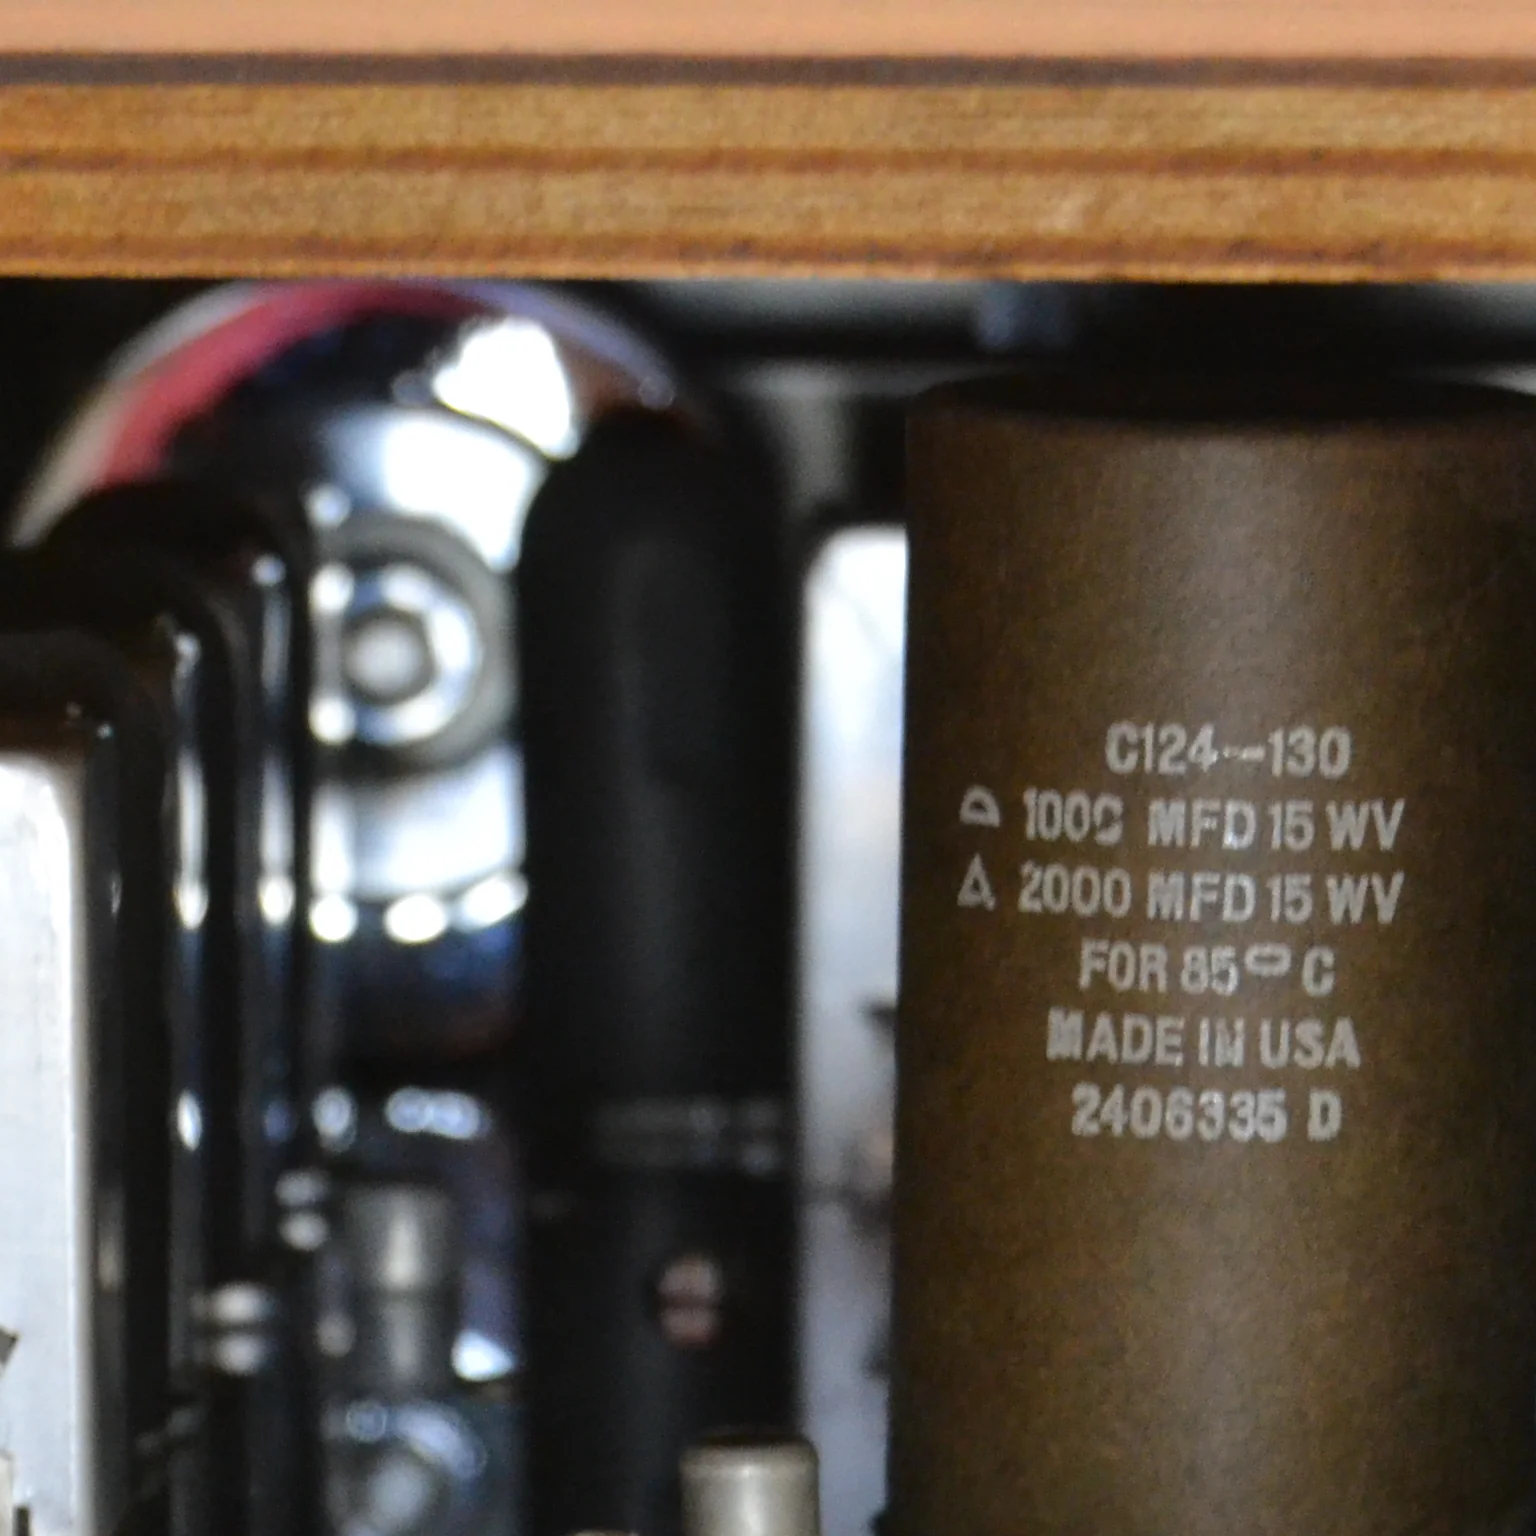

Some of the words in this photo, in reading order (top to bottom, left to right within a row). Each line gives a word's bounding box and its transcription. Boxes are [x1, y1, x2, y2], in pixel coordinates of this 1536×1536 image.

[1147, 798, 1257, 850] MFD
[1270, 800, 1315, 851] 15
[1326, 799, 1406, 851] WV
[1019, 861, 1131, 918] 2000
[1147, 871, 1257, 923] MFD
[1270, 872, 1315, 924] 15
[1327, 870, 1406, 924] WV
[1079, 937, 1168, 993] FOR
[1046, 1006, 1185, 1067] MADE
[1199, 1017, 1246, 1068] IN
[1260, 1017, 1361, 1069] USA
[1071, 1083, 1287, 1142] 2406335
[1307, 1088, 1343, 1142] D
